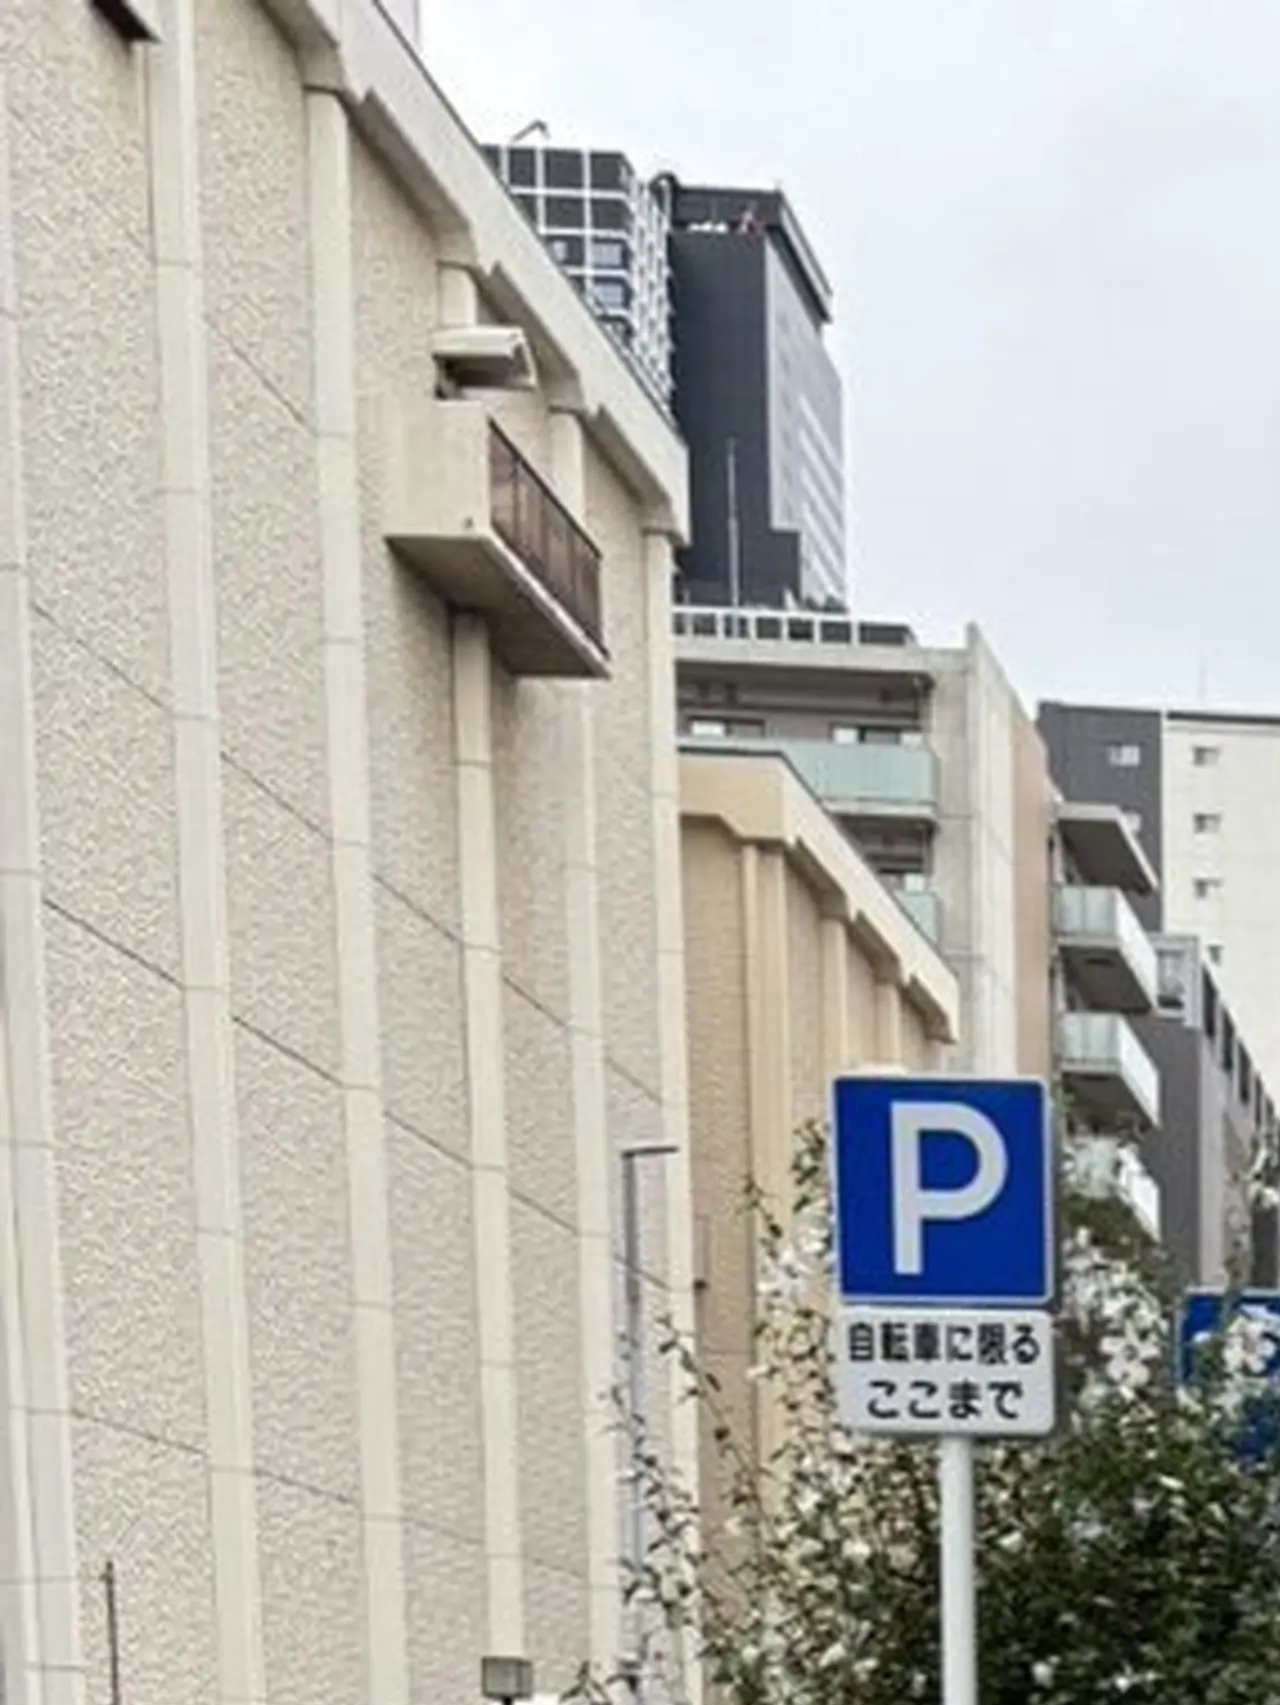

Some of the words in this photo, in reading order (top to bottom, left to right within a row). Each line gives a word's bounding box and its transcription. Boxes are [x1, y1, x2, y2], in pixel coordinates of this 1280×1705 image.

[890, 1101, 1008, 1275] P
[848, 1322, 1040, 1364] 自転車に限る
[867, 1380, 1023, 1419] ここまで
